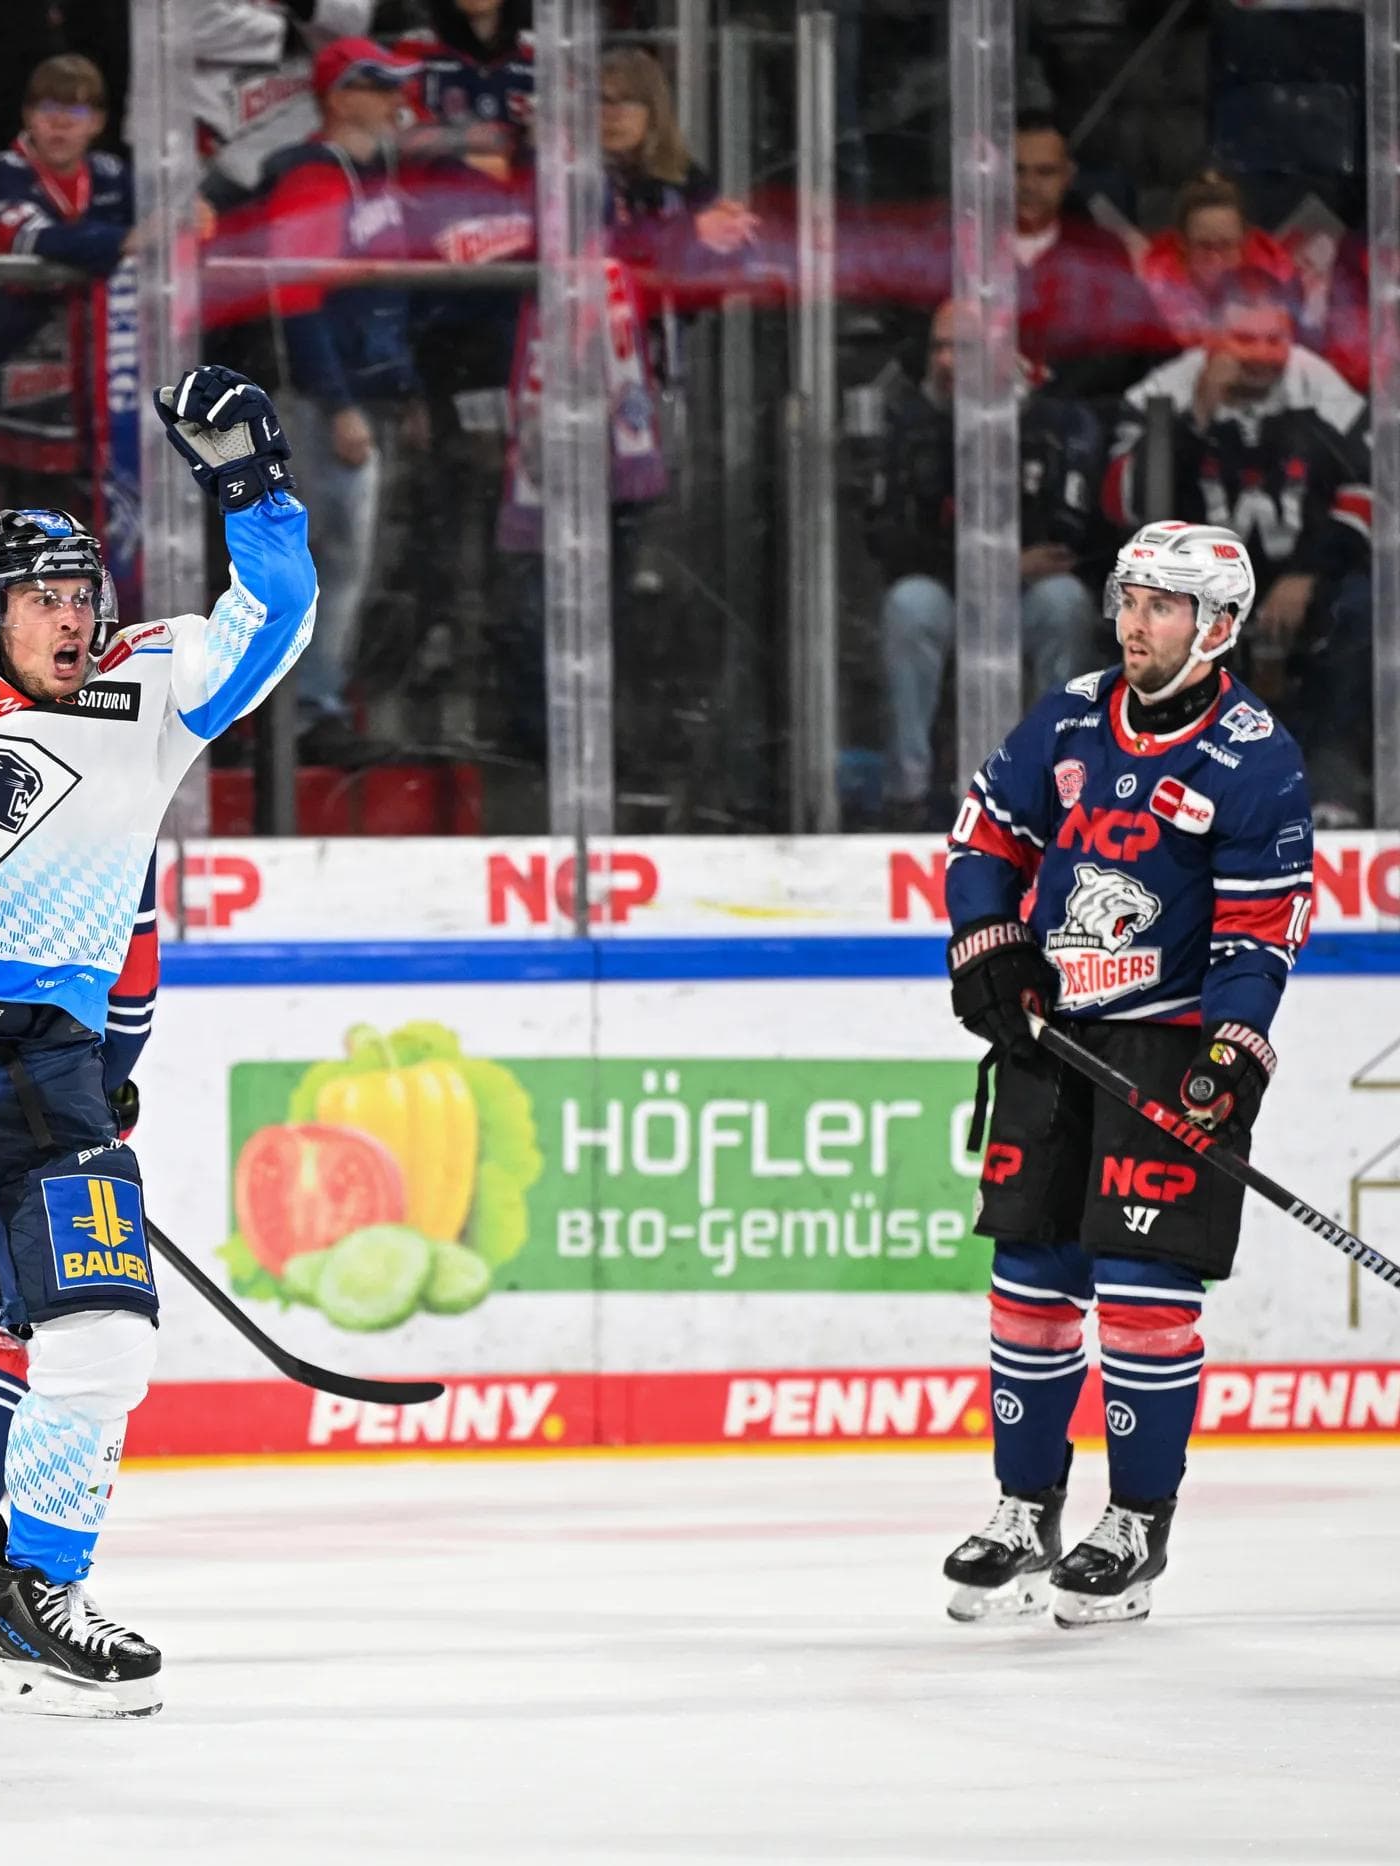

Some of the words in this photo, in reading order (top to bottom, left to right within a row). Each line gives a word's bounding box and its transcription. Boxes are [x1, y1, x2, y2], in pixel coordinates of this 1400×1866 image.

[77, 689, 132, 711] SATURN
[1056, 801, 1160, 862] NCP
[486, 853, 660, 926] NCP
[1101, 1155, 1198, 1203] NCP
[62, 1250, 150, 1285] BAUER
